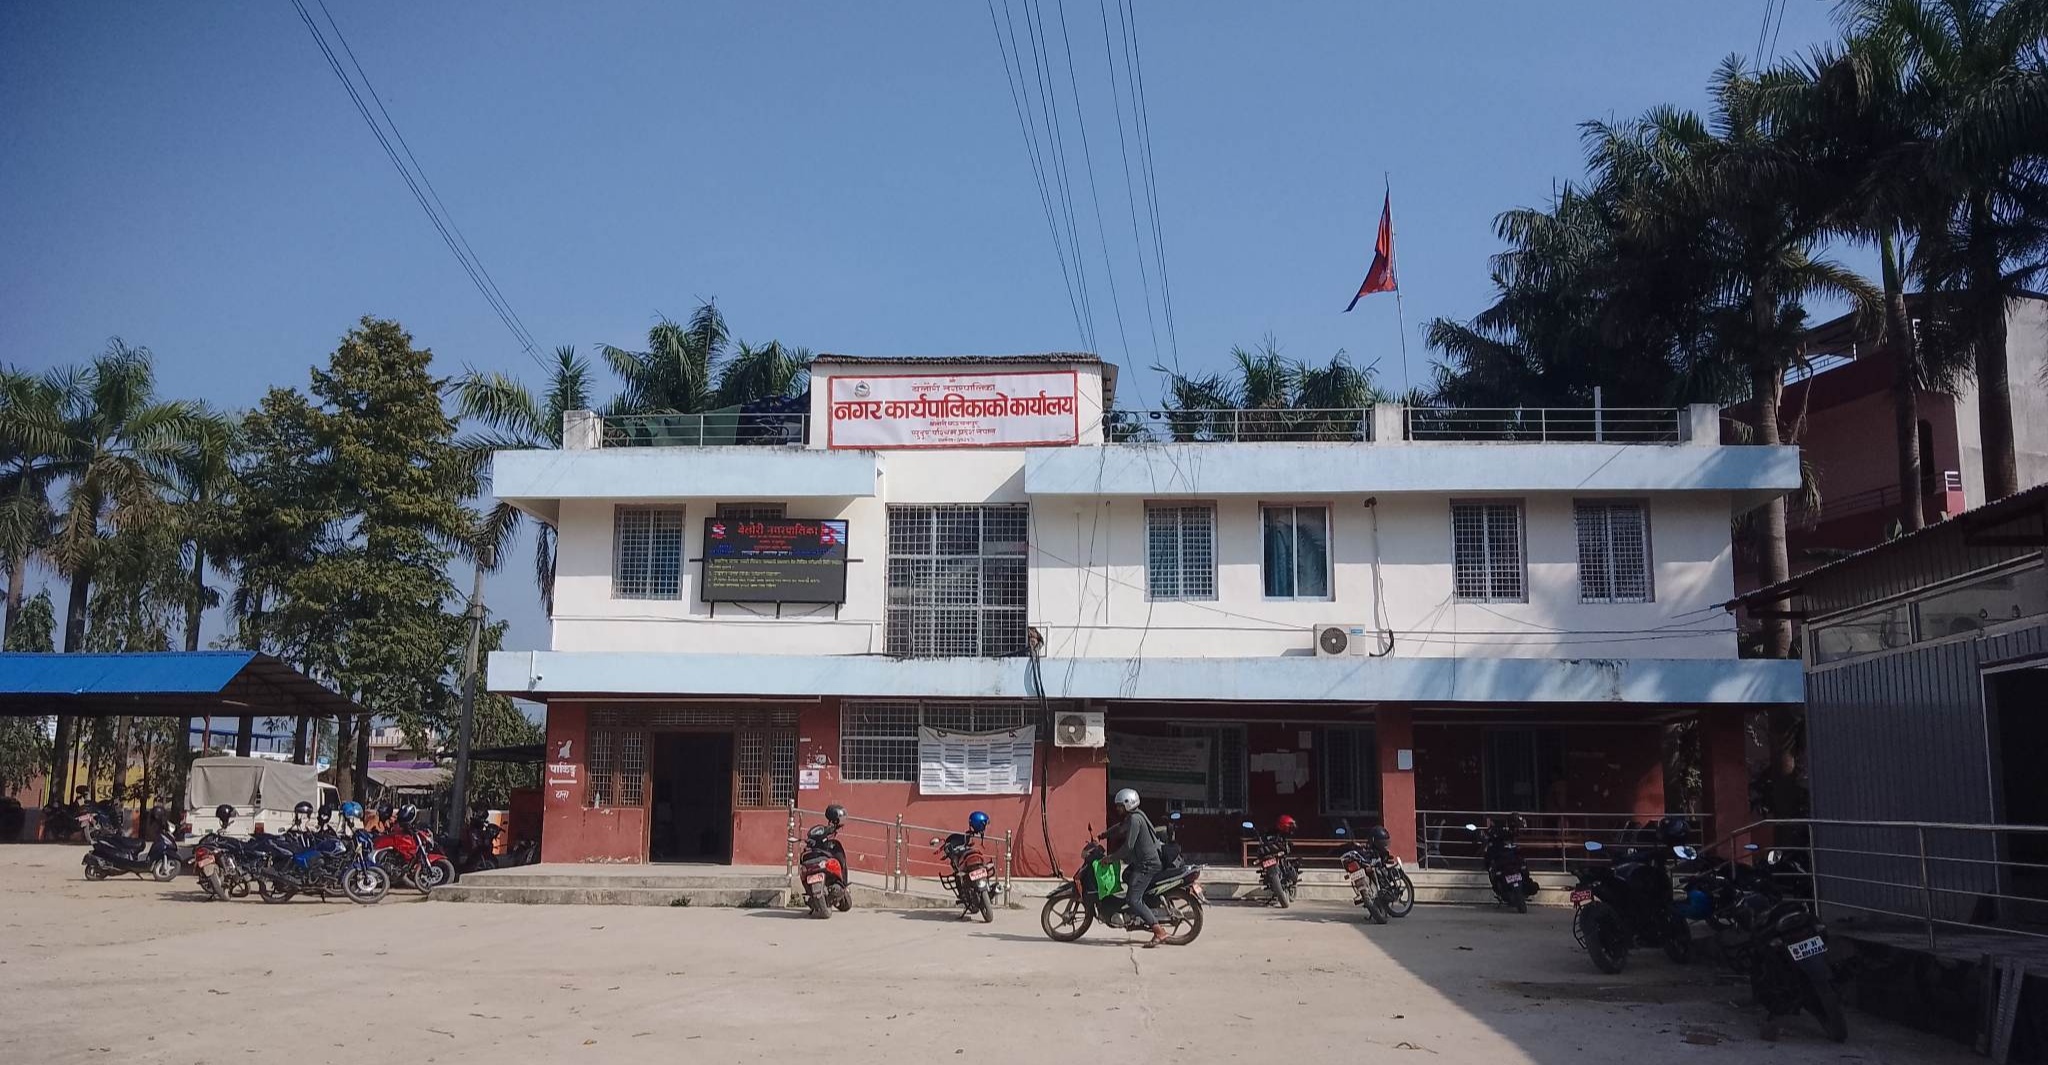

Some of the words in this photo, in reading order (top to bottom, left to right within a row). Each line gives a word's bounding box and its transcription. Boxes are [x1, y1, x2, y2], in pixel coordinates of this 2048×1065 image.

[834, 400, 882, 420] नगर
[884, 393, 1008, 419] कार्यपालिकाको
[1009, 390, 1074, 416] कार्यालय
[767, 523, 818, 536] नगरपालिका
